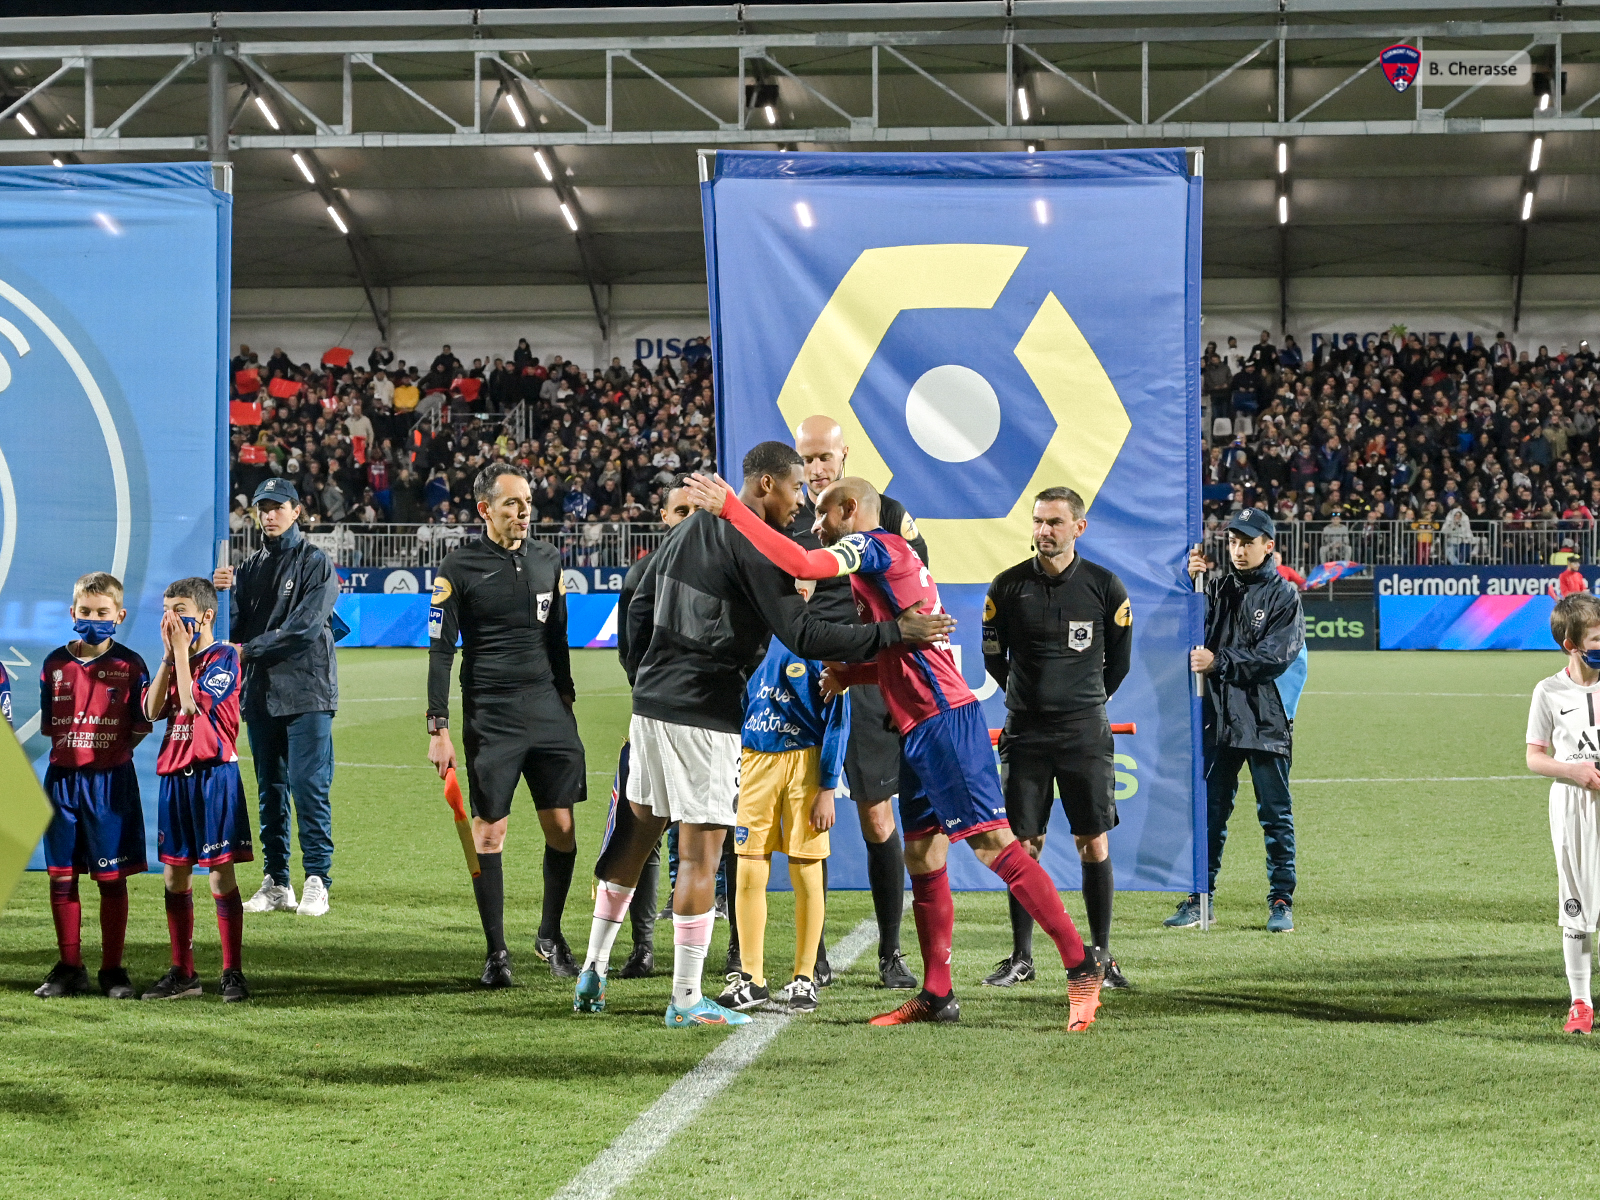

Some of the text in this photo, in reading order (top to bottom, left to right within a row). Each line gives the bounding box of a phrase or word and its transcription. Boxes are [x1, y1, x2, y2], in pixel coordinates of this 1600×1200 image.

[1378, 573, 1480, 596] clermont
[1304, 616, 1365, 639] Eats
[67, 731, 117, 741] CLERMONT
[1564, 932, 1587, 940] PARIS
